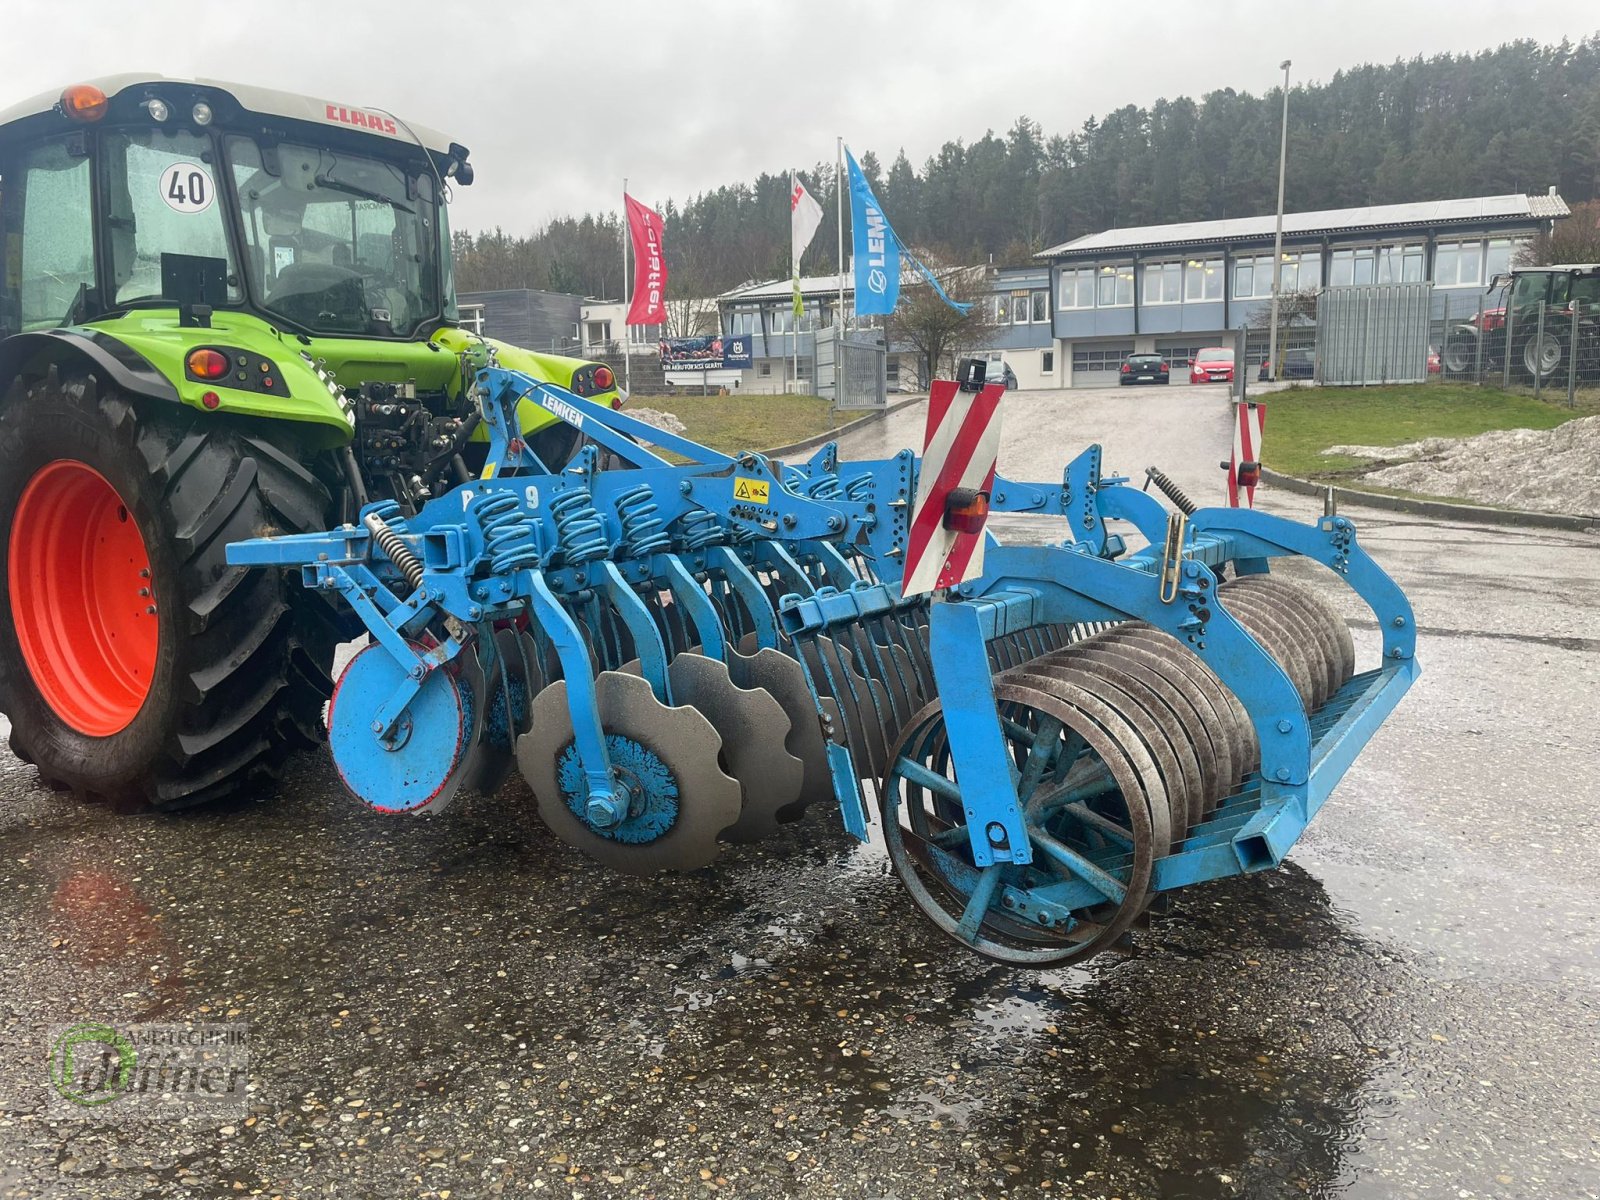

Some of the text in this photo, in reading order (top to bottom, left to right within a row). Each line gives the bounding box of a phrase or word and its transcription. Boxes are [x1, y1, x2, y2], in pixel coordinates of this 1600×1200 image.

[326, 104, 396, 135] CLAAS
[169, 170, 205, 206] 40
[541, 393, 584, 428] LEMKEN
[525, 485, 539, 509] 9
